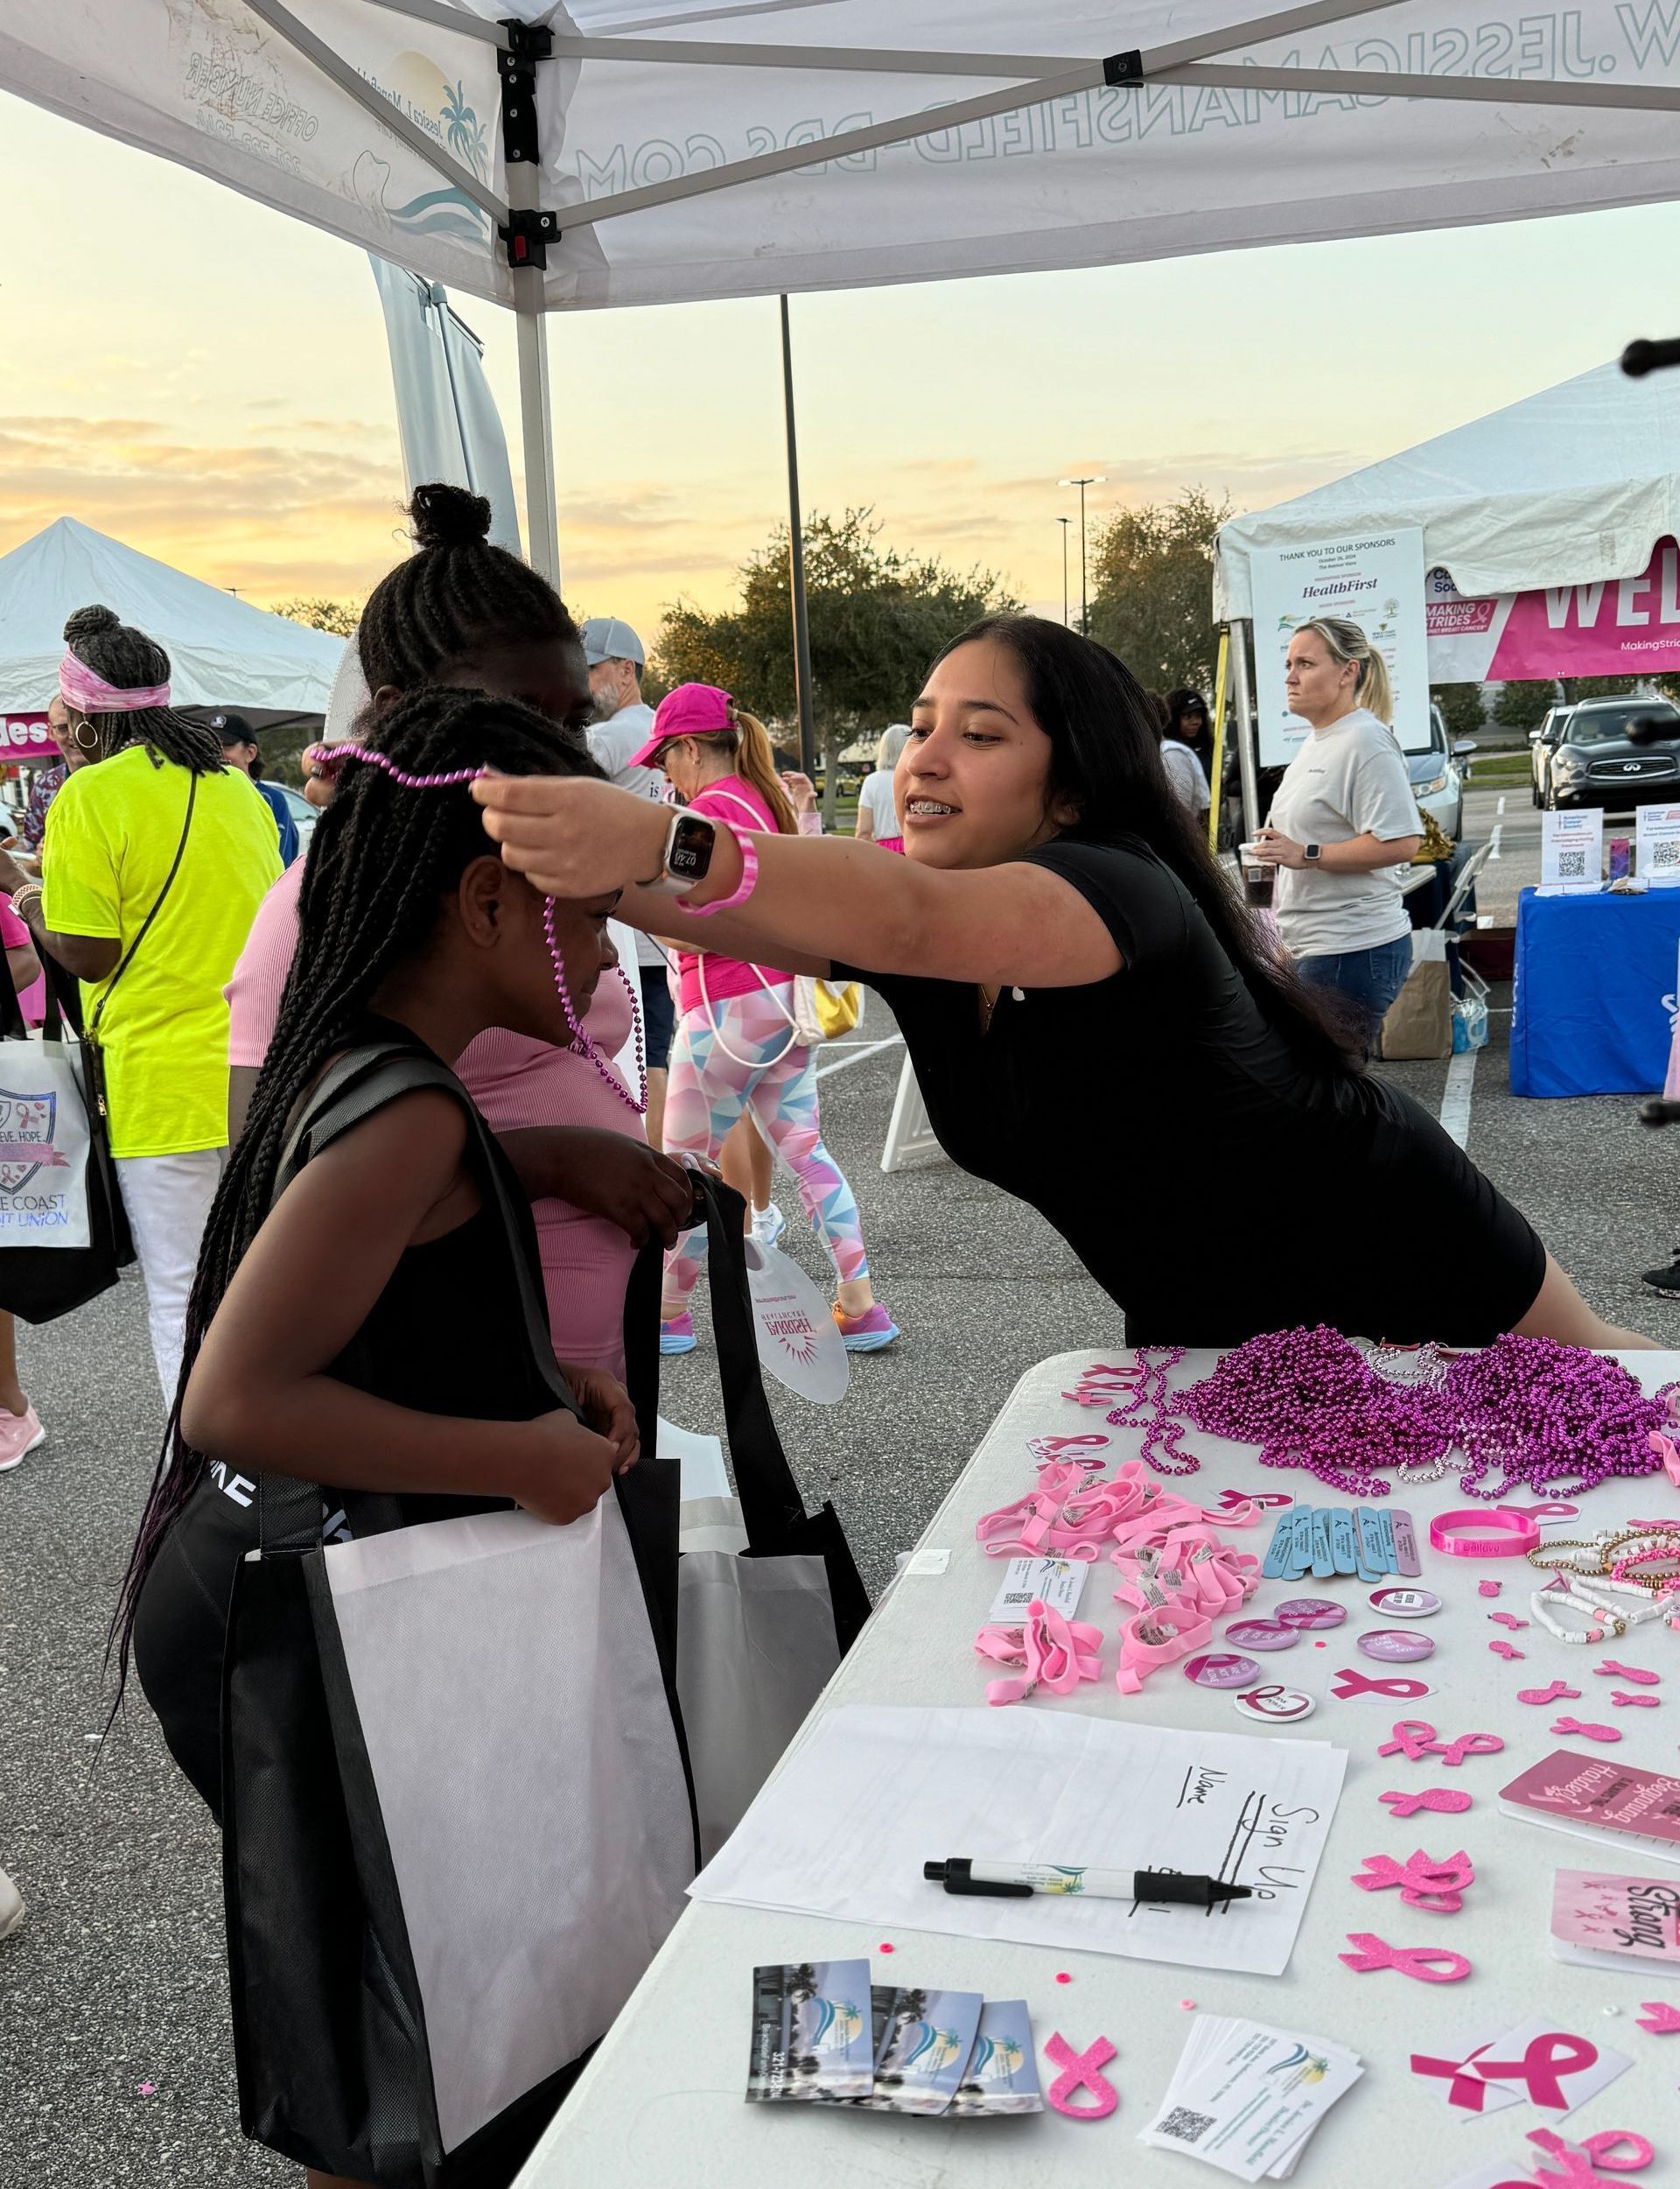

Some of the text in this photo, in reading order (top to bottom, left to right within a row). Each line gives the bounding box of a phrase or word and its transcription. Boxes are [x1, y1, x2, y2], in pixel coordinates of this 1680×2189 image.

[1279, 552, 1305, 561] THANK
[1336, 544, 1353, 553] OUR
[1355, 538, 1396, 551] SPONSORS
[650, 782, 659, 797] is
[12, 1195, 66, 1211] COAST
[1186, 1766, 1228, 1804] Name
[1241, 1803, 1320, 1848] Sign
[1613, 1885, 1680, 1949] Strong
